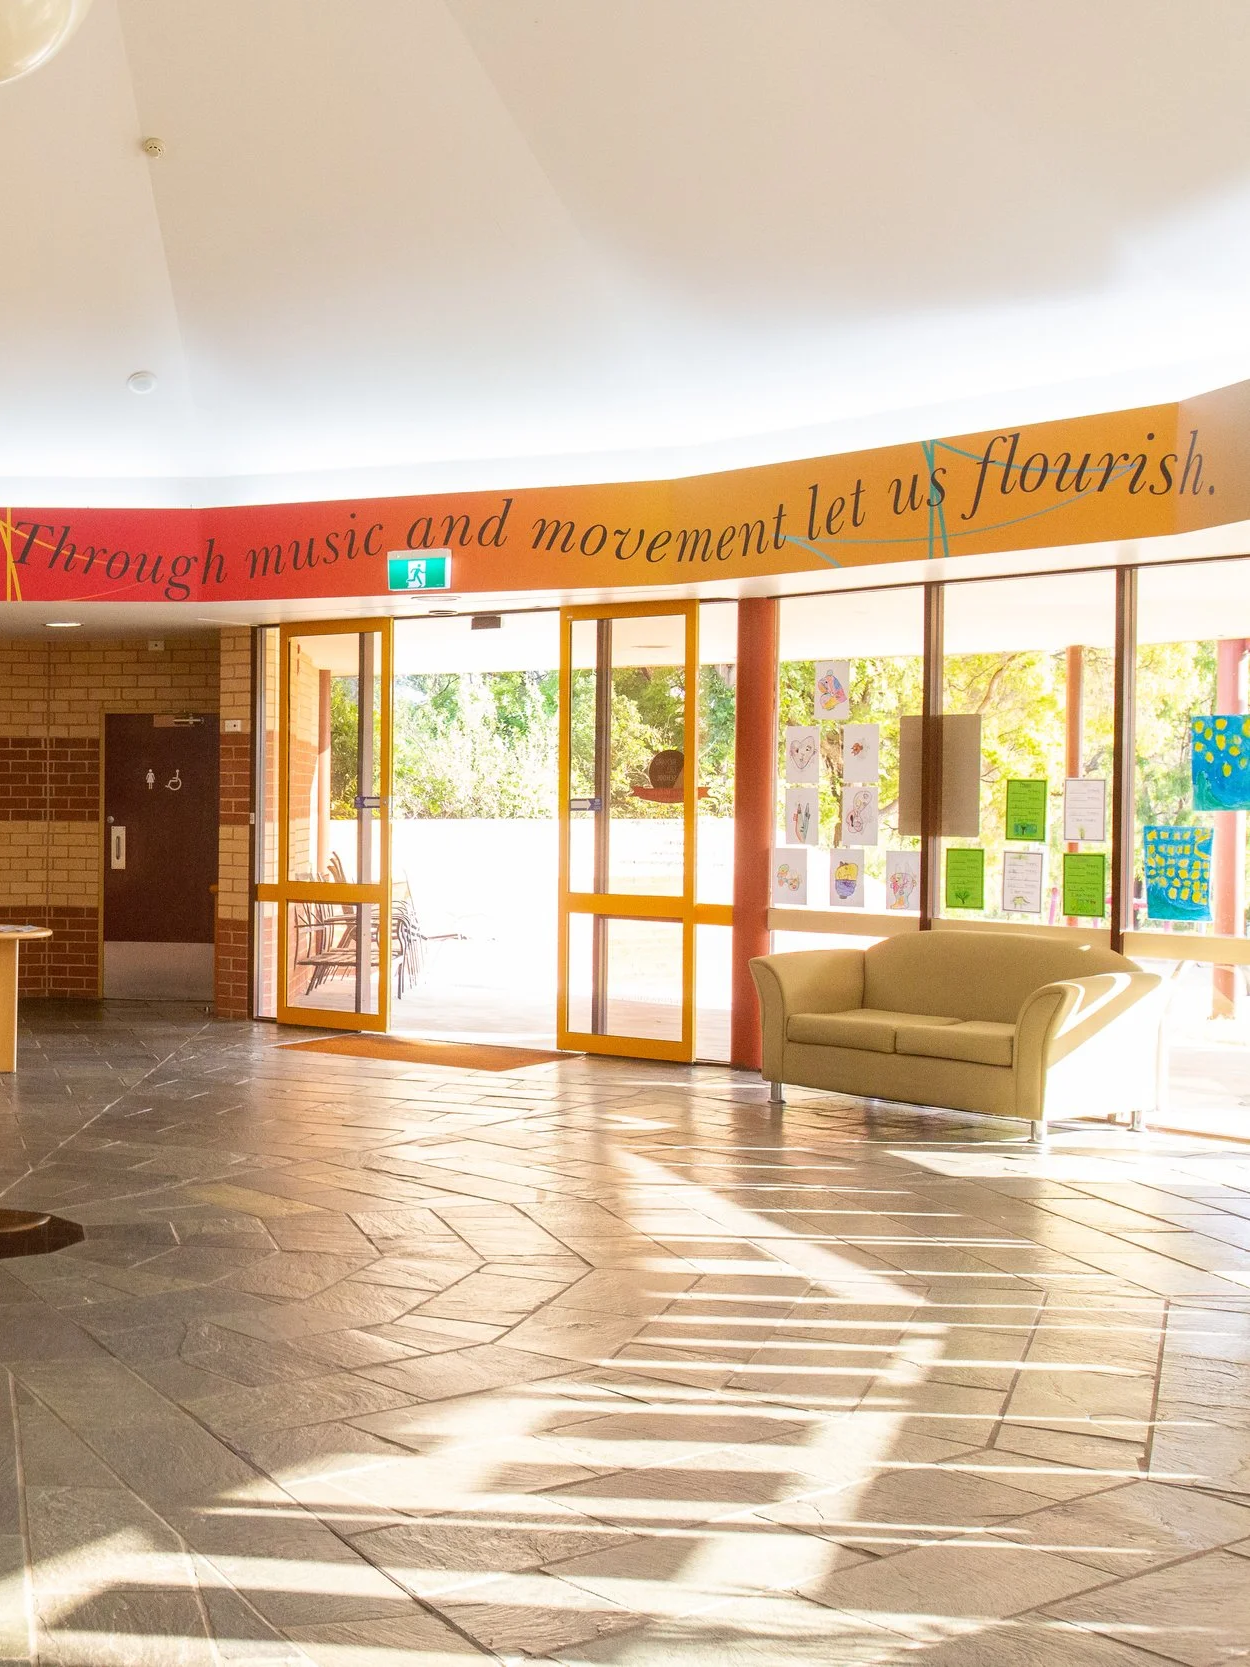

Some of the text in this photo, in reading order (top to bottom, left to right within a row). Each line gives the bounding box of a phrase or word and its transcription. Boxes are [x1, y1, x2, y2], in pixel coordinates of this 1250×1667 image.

[12, 429, 1216, 600] Through music and movement let us flourish.
